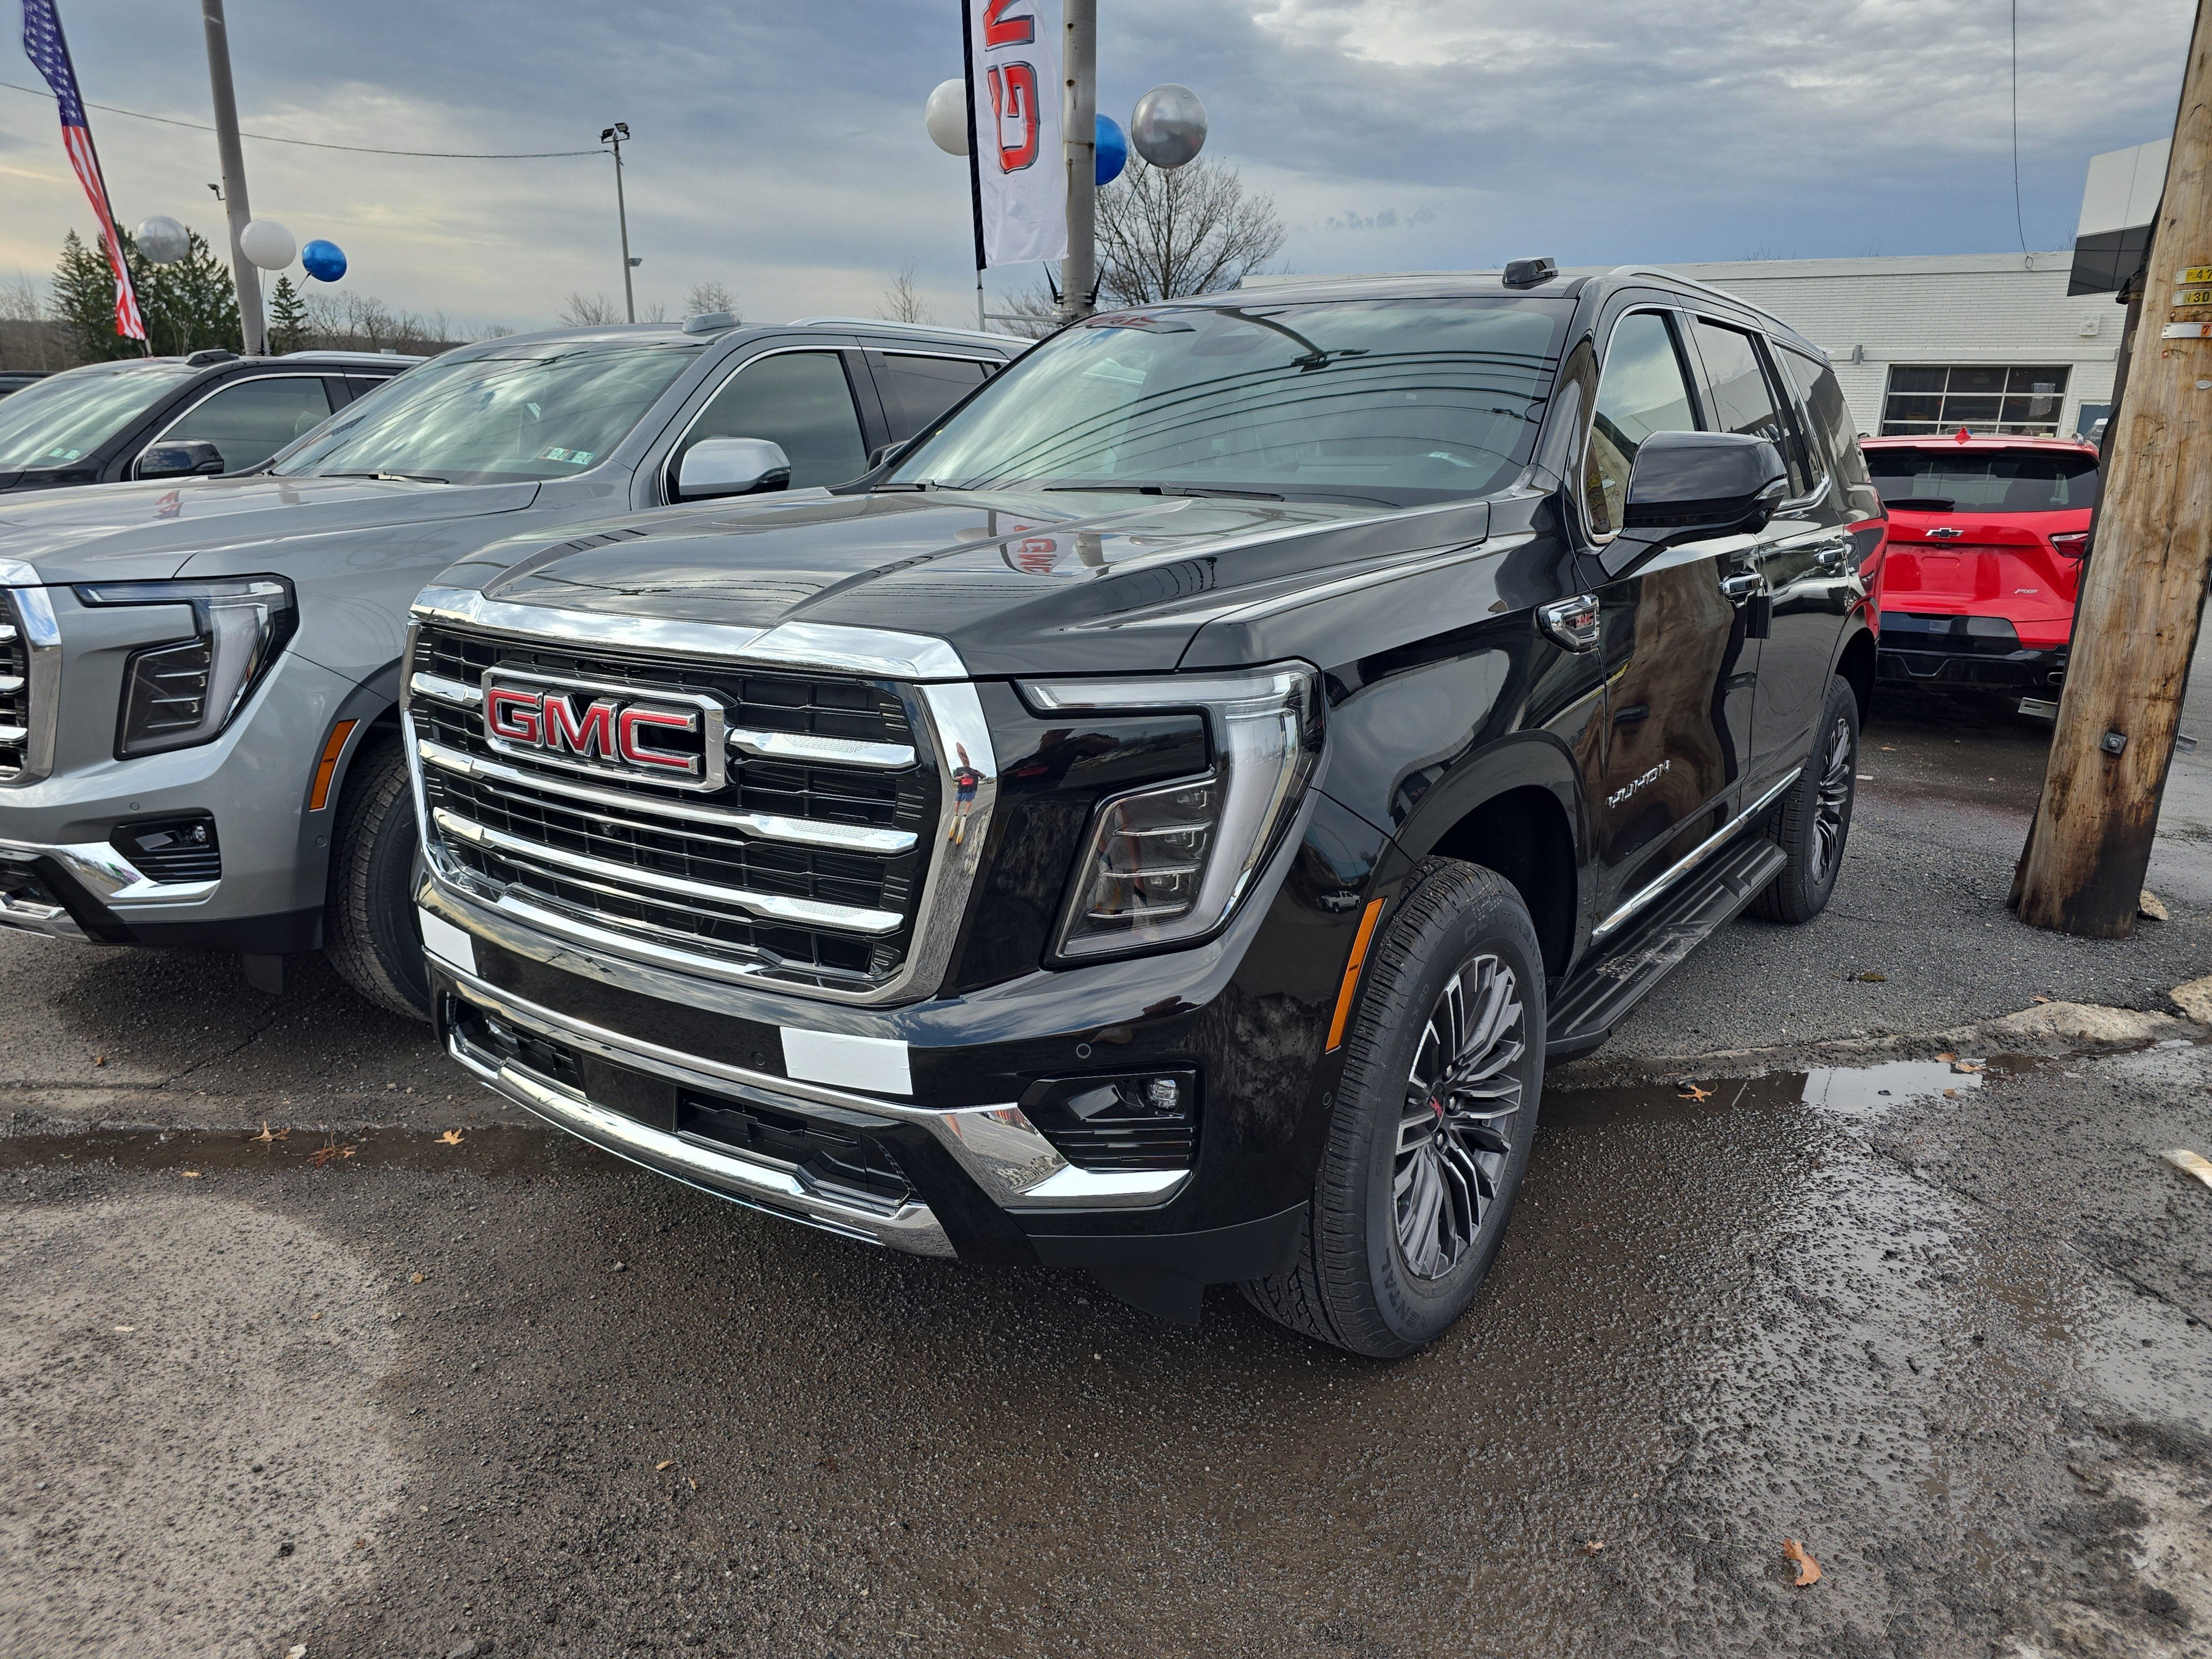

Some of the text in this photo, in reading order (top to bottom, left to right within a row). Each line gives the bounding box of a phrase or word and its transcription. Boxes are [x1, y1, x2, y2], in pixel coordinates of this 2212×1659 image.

[488, 684, 699, 775] GMC
[1605, 759, 1671, 809] YUKON
[1419, 984, 1430, 1006] 20
